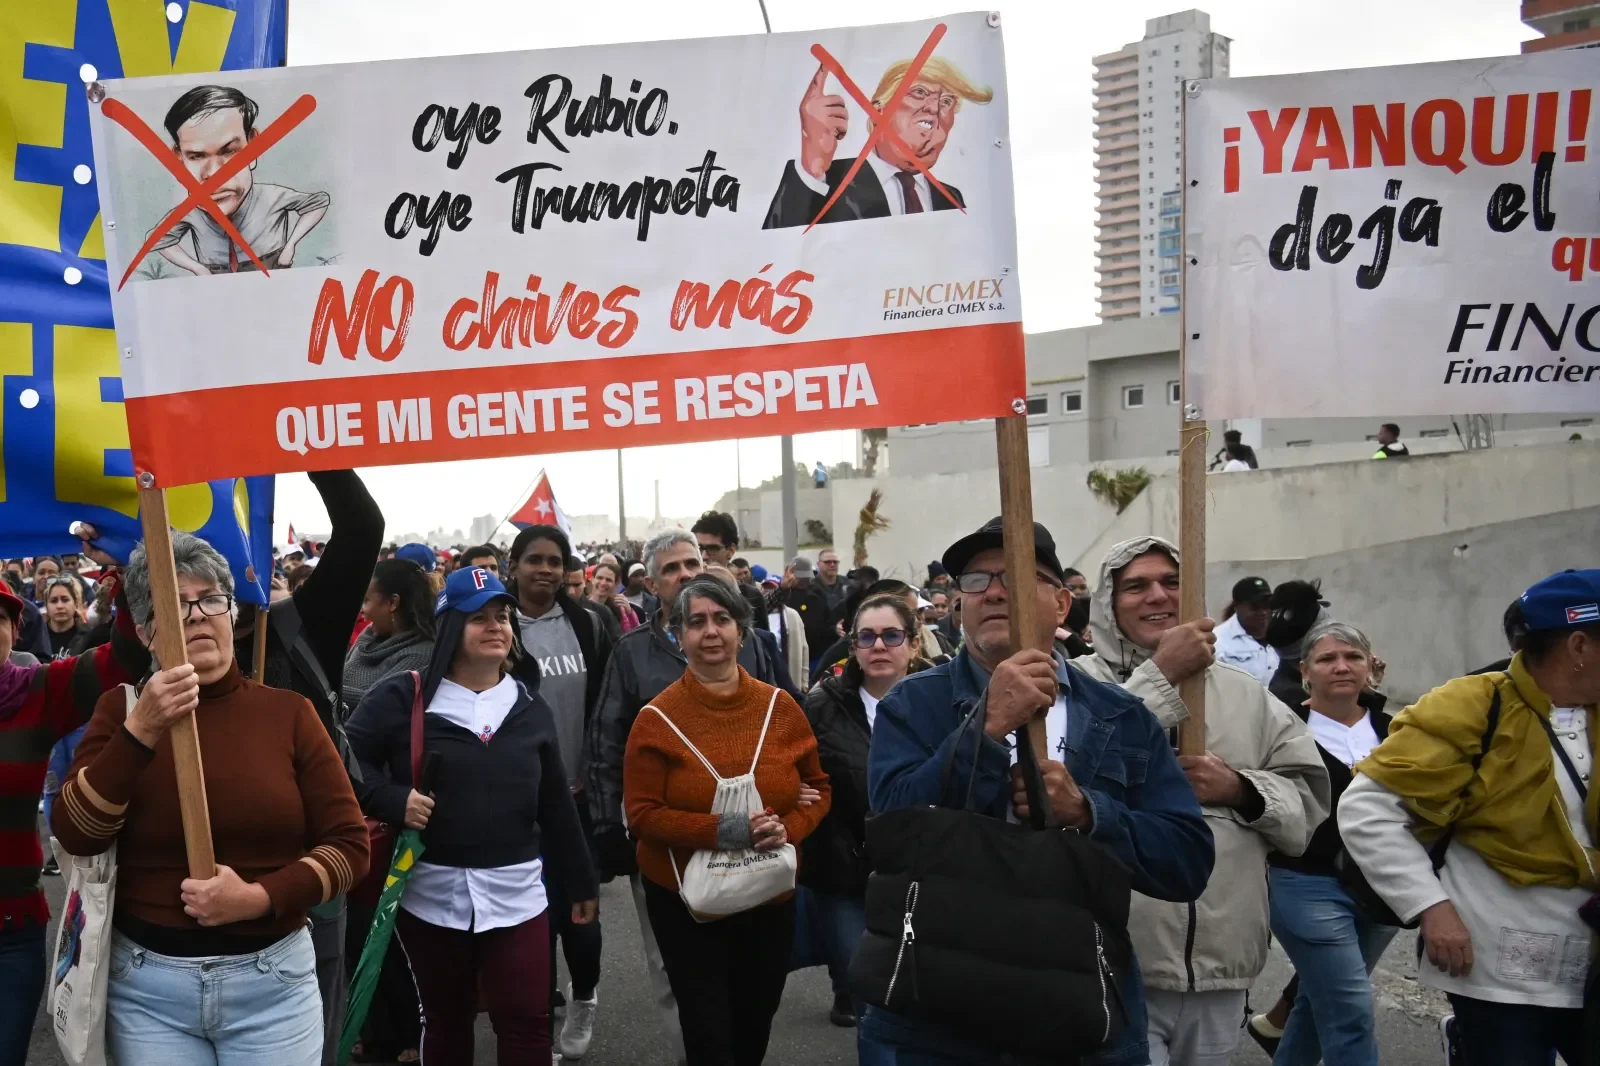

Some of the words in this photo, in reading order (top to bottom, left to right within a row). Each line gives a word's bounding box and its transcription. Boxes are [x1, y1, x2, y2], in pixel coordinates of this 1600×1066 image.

[412, 102, 502, 170] oye
[524, 73, 679, 153] Rubio.
[1223, 89, 1592, 193] ¡YANQUI!
[384, 190, 473, 257] oye
[495, 149, 741, 242] Trumpeta
[1268, 179, 1443, 290] deja
[1486, 151, 1556, 233] el
[307, 268, 414, 366] NO
[442, 270, 640, 349] chives
[669, 263, 816, 335] más
[883, 278, 1003, 309] FINCIMEX
[883, 306, 943, 321] Financiera
[947, 301, 985, 315] CIMEX
[988, 300, 1005, 311] s.a.
[276, 405, 364, 456] QUE
[377, 395, 432, 444] MI
[447, 385, 589, 438] GENTE
[602, 380, 661, 427] SE
[674, 362, 879, 422] RESPETA
[1443, 357, 1600, 384] Financier
[472, 568, 488, 590] F
